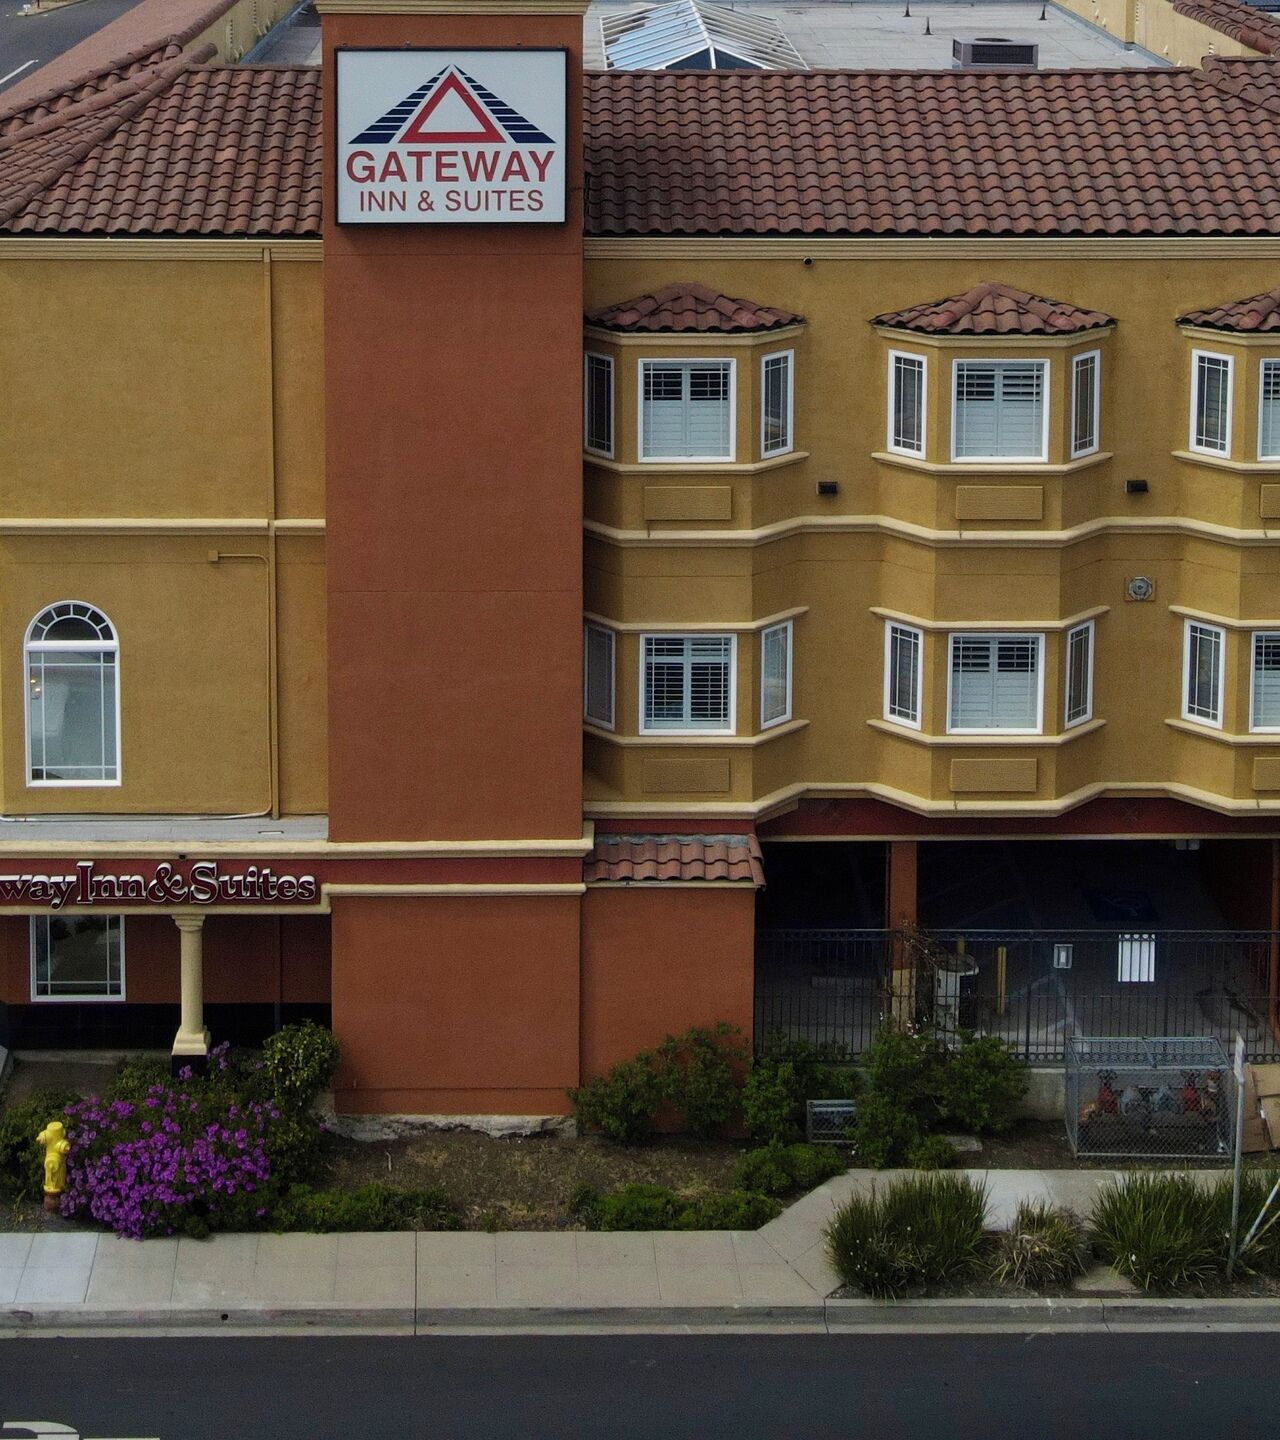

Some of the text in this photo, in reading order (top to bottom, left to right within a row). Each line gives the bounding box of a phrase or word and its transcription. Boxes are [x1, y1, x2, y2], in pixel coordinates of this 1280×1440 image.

[346, 150, 555, 184] GATEWAY
[360, 189, 544, 212] INN & SUITES
[77, 861, 147, 905] Inn
[189, 860, 317, 905] Suites
